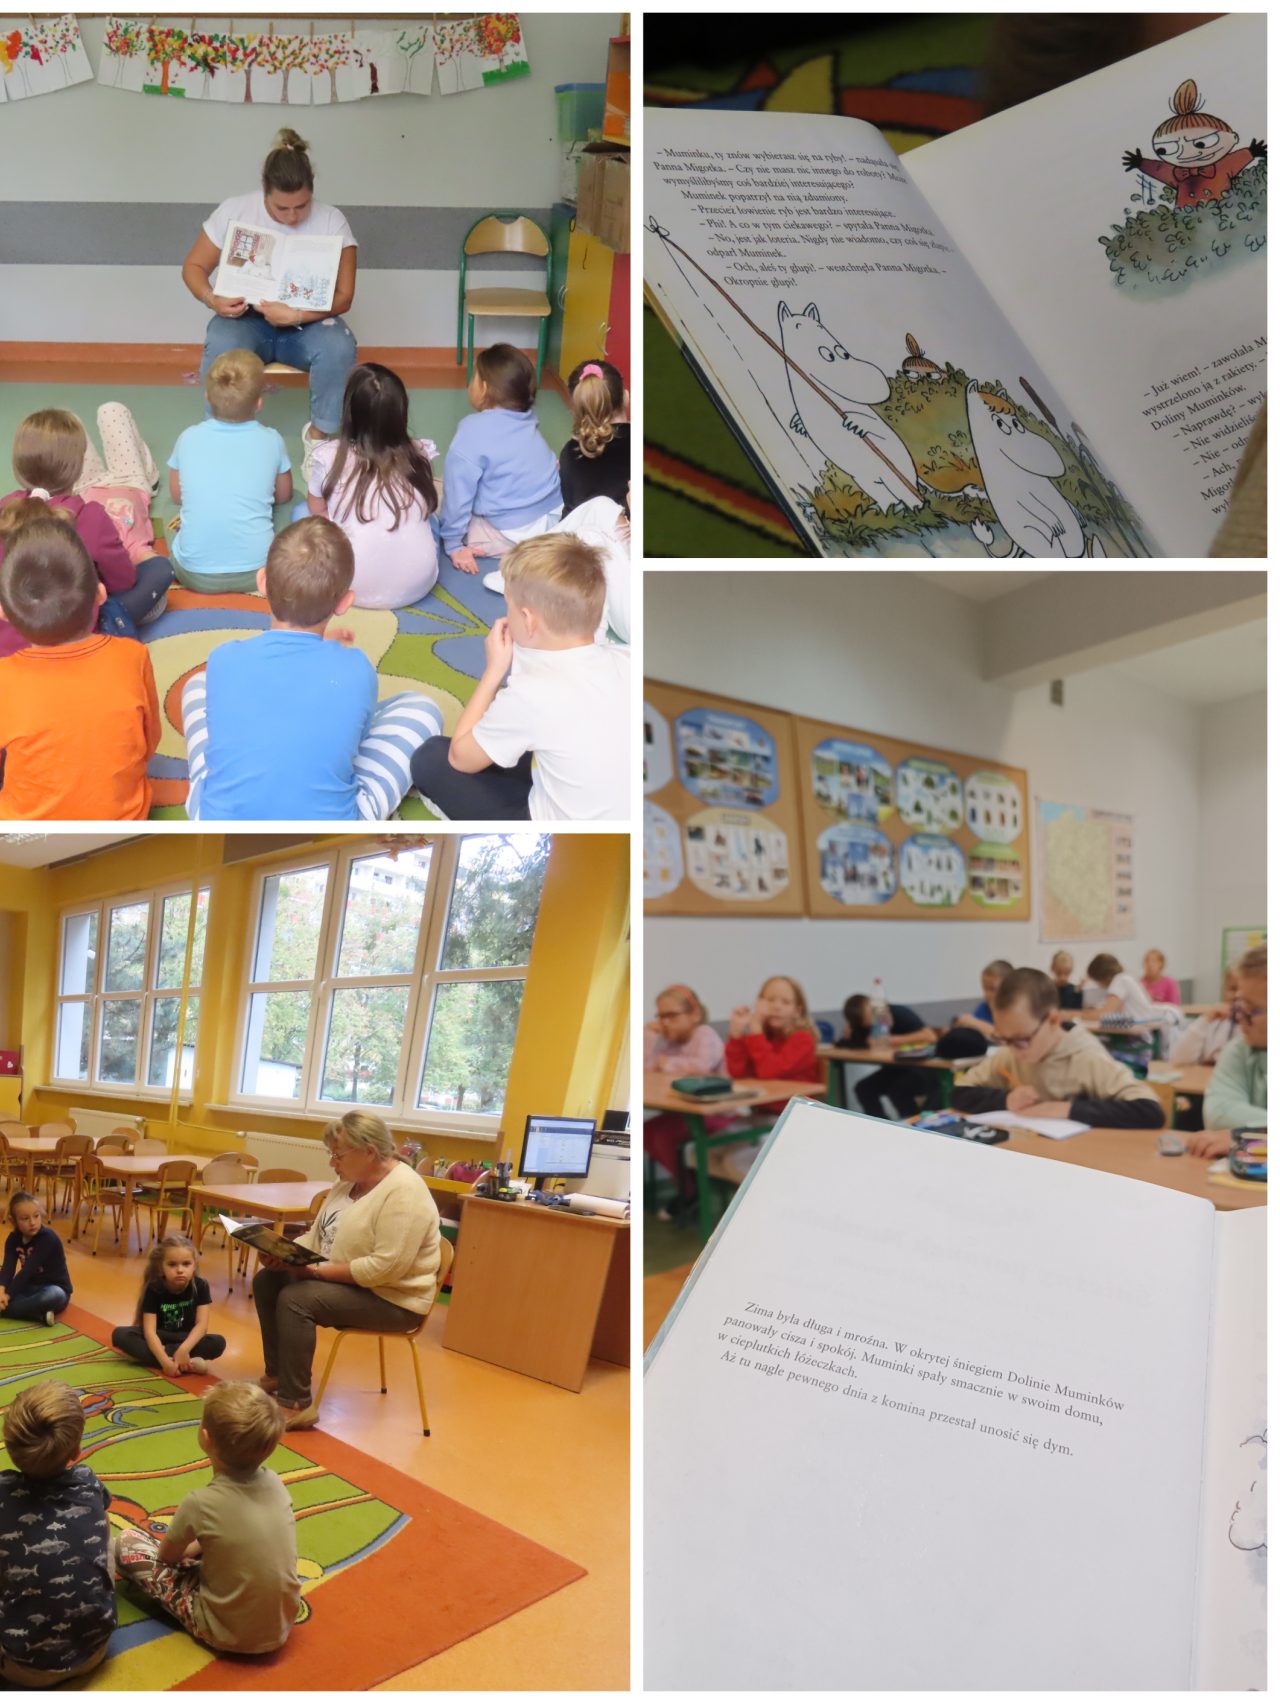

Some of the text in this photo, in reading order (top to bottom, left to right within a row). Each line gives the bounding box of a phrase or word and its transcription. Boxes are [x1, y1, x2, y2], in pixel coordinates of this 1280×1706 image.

[664, 149, 713, 159] Muminku,
[715, 151, 724, 162] ty
[727, 151, 750, 159] znów
[753, 151, 795, 161] wybierasz
[797, 153, 809, 162] się
[825, 153, 846, 164] ryby!
[653, 162, 683, 171] Panna
[683, 163, 726, 173] Migotka.
[736, 165, 754, 175] Czy
[812, 168, 841, 176] innego
[843, 167, 854, 175] do
[856, 170, 886, 180] roboty?
[737, 179, 751, 187] coś
[753, 179, 789, 188] bardziej
[791, 179, 854, 190] interesującego?
[681, 190, 726, 200] Muminek
[729, 192, 771, 202] popatrzył
[787, 194, 802, 203] nią
[803, 193, 848, 203] zdumiony.
[697, 205, 736, 214] Przecież
[737, 206, 777, 215] łowienie
[779, 208, 793, 218] ryb
[796, 208, 809, 218] jest
[813, 206, 843, 215] bardzo
[845, 207, 896, 218] interesujące.
[706, 219, 727, 228] Phi!
[728, 220, 737, 228] A
[763, 223, 781, 231] tym
[783, 221, 832, 232] ciekawego?
[843, 221, 874, 231] spytała
[874, 221, 900, 231] Panna
[901, 223, 935, 236] Migotka.
[715, 234, 735, 243] No,
[736, 235, 750, 243] jest
[752, 235, 767, 245] jak
[767, 235, 800, 244] loteria.
[800, 235, 828, 245] Nigdy
[831, 235, 844, 243] nie
[845, 236, 888, 245] wiadomo,
[889, 238, 903, 246] czy
[918, 240, 929, 249] się
[706, 248, 787, 258] odparł Muminek.
[733, 262, 758, 272] Och,
[760, 264, 777, 272] aleś
[790, 264, 816, 274] głupi!
[826, 263, 875, 273] westchnęła
[875, 263, 903, 272] Panna
[903, 263, 940, 274] Migotka.
[724, 276, 798, 288] Okropnie głupi!
[1151, 382, 1169, 396] Już
[1170, 367, 1201, 386] wiem!
[1212, 344, 1254, 368] zawołała
[1254, 336, 1267, 348] M
[1141, 387, 1201, 417] wystrzelono
[1202, 382, 1213, 392] ją
[1222, 362, 1257, 382] rakiety.
[1151, 385, 1246, 430] Doliny Muminków.
[1180, 405, 1237, 435] Naprawdę?
[1189, 437, 1210, 449] Nie
[1200, 449, 1220, 463] Nie
[1212, 462, 1236, 477] Ach,
[717, 1332, 858, 1379] w cieplutkich łóżeczkach.
[744, 1301, 1125, 1411] Zima była długa i mroźna. W okrytej śniegiem Dolinie Muminków
[723, 1316, 1104, 1426] panowały cisza i spokój. Muminki spały smacznie w swoim domu,
[720, 1350, 1074, 1457] Aż tu nagle pewnego dnia z komina przestał unosić się dym.
